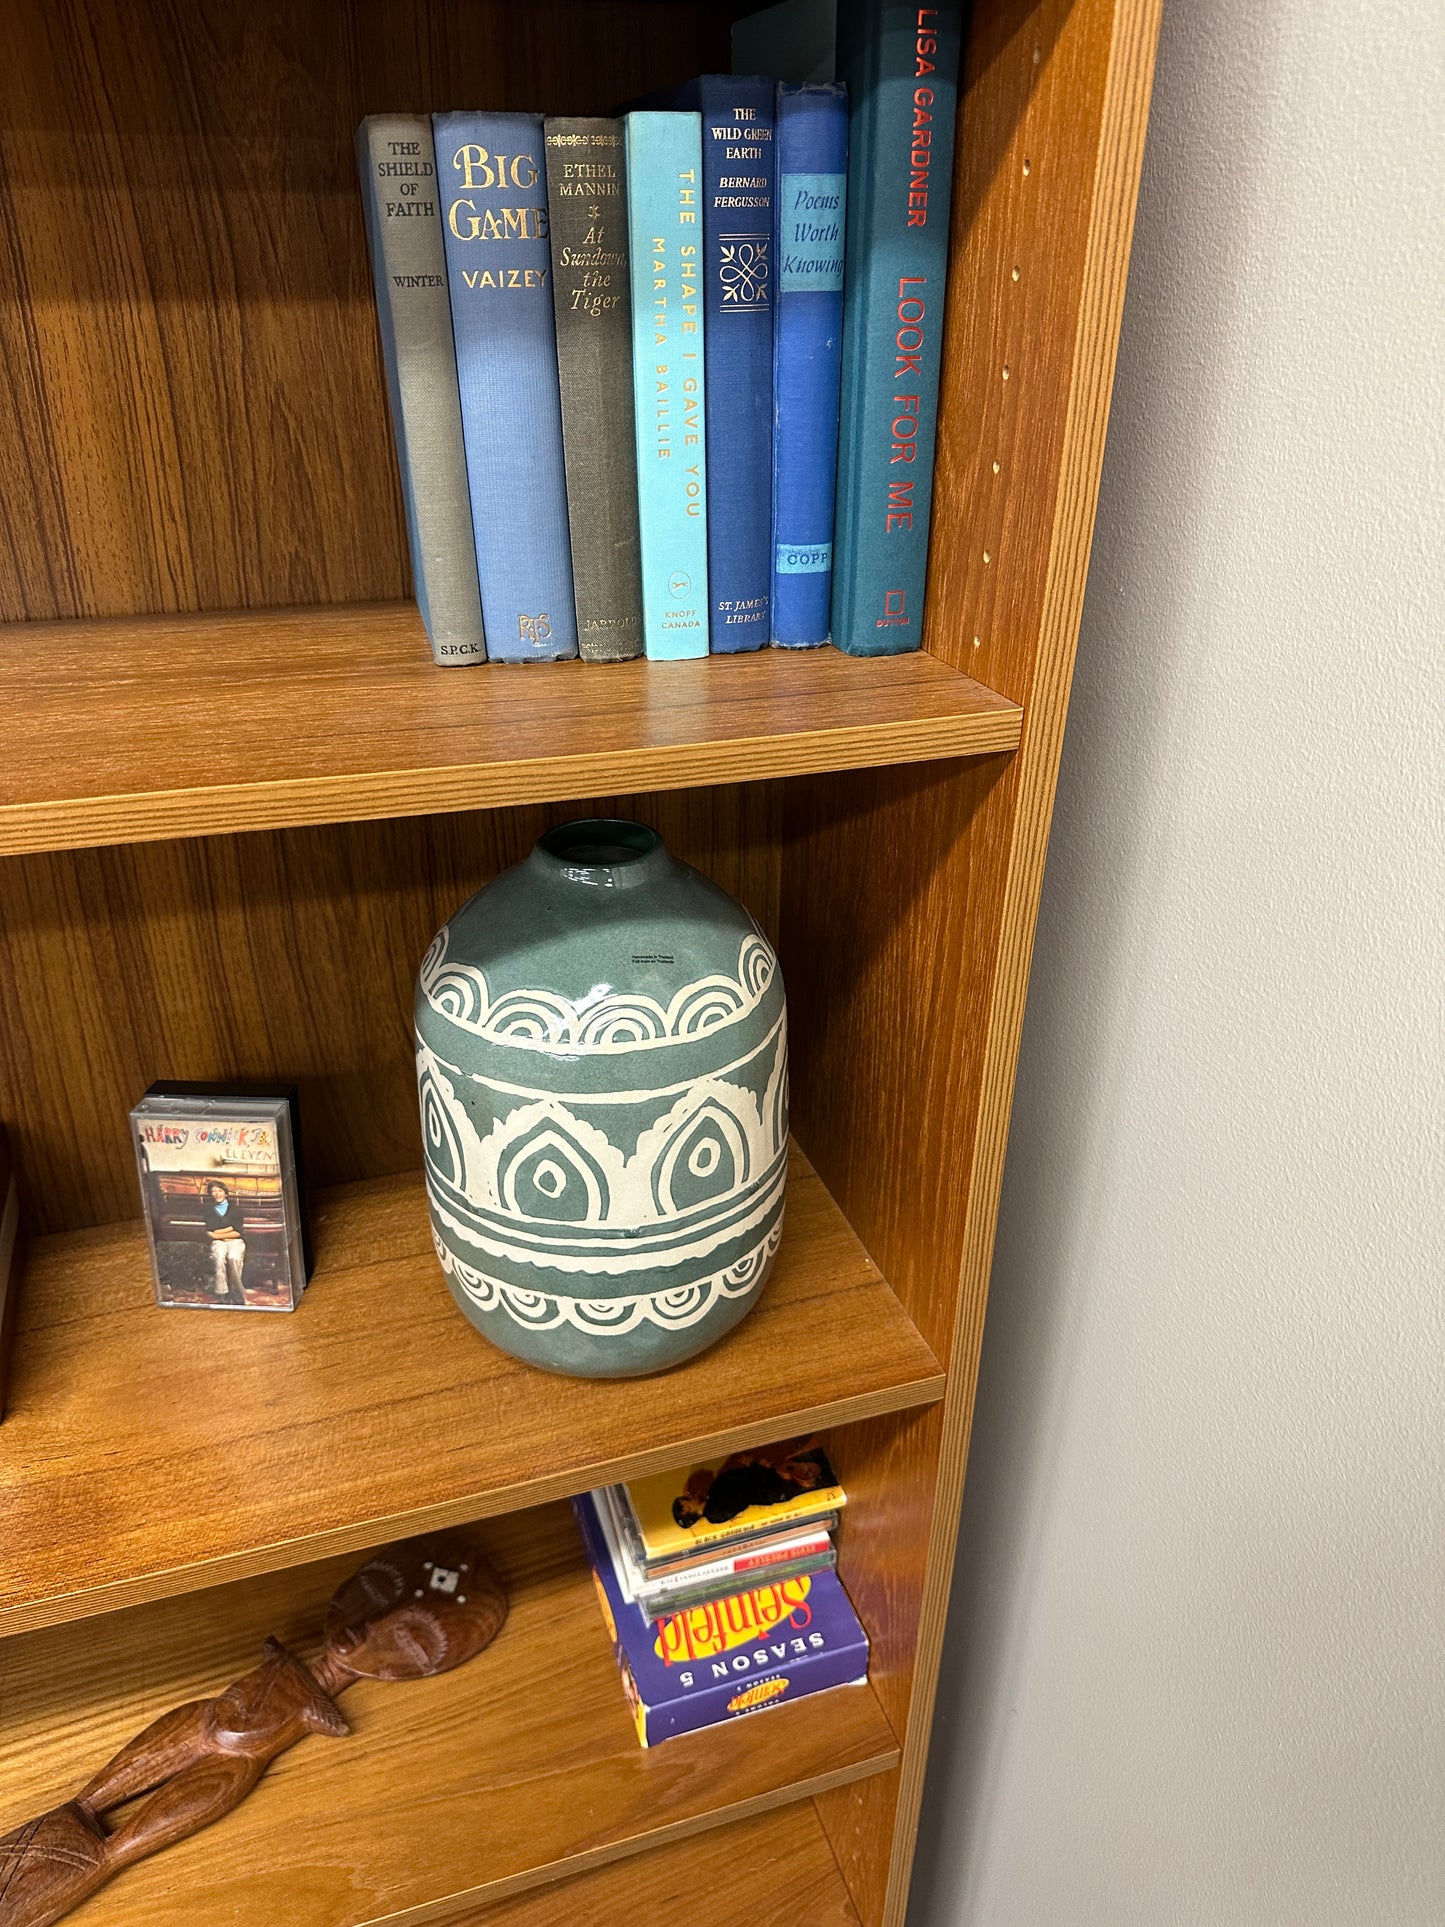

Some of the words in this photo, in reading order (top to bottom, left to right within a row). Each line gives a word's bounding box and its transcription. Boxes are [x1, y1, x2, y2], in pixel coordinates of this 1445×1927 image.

[915, 8, 938, 77] LISA
[733, 108, 756, 121] THE
[711, 127, 742, 140] WILD
[744, 128, 772, 141] GREEN
[388, 142, 421, 156] THE
[726, 148, 761, 159] EARTH
[907, 87, 934, 227] GARDNER
[378, 162, 433, 177] SHIELD
[453, 144, 540, 189] BIG
[563, 164, 616, 178] ETHEL
[400, 183, 419, 196] OF
[559, 182, 620, 196] MANNIN
[719, 177, 767, 188] BERNARD
[679, 169, 695, 224] THE
[713, 196, 770, 208] FERGUSSON
[794, 191, 840, 210] Poems
[386, 202, 435, 217] FAITH
[449, 199, 549, 241] GAME
[582, 227, 605, 244] At
[794, 223, 839, 242] Worth
[783, 255, 844, 277] Knowing
[393, 275, 445, 288] WINTER
[462, 269, 547, 288] VAIZEY
[583, 270, 611, 287] the
[652, 238, 668, 345] MARTHA
[681, 245, 697, 333] SHAPE
[571, 289, 620, 317] Tiger
[894, 277, 927, 378] LOOK
[656, 365, 671, 458] BAILLIE
[683, 378, 699, 446] GAVE
[890, 395, 920, 464] FOR
[686, 464, 700, 517] YOU
[886, 481, 915, 533] ME
[787, 552, 828, 566] COPP
[664, 610, 697, 619] KNOPF
[718, 601, 733, 611] ST.
[661, 620, 701, 629] CANADA
[725, 611, 767, 625] LIBRARY
[226, 1148, 275, 1160] ELEVEN
[747, 1549, 788, 1566] PRESLEY
[790, 1544, 817, 1557] ELVIS
[711, 1632, 825, 1678] SEASON
[680, 1671, 695, 1687] 5
